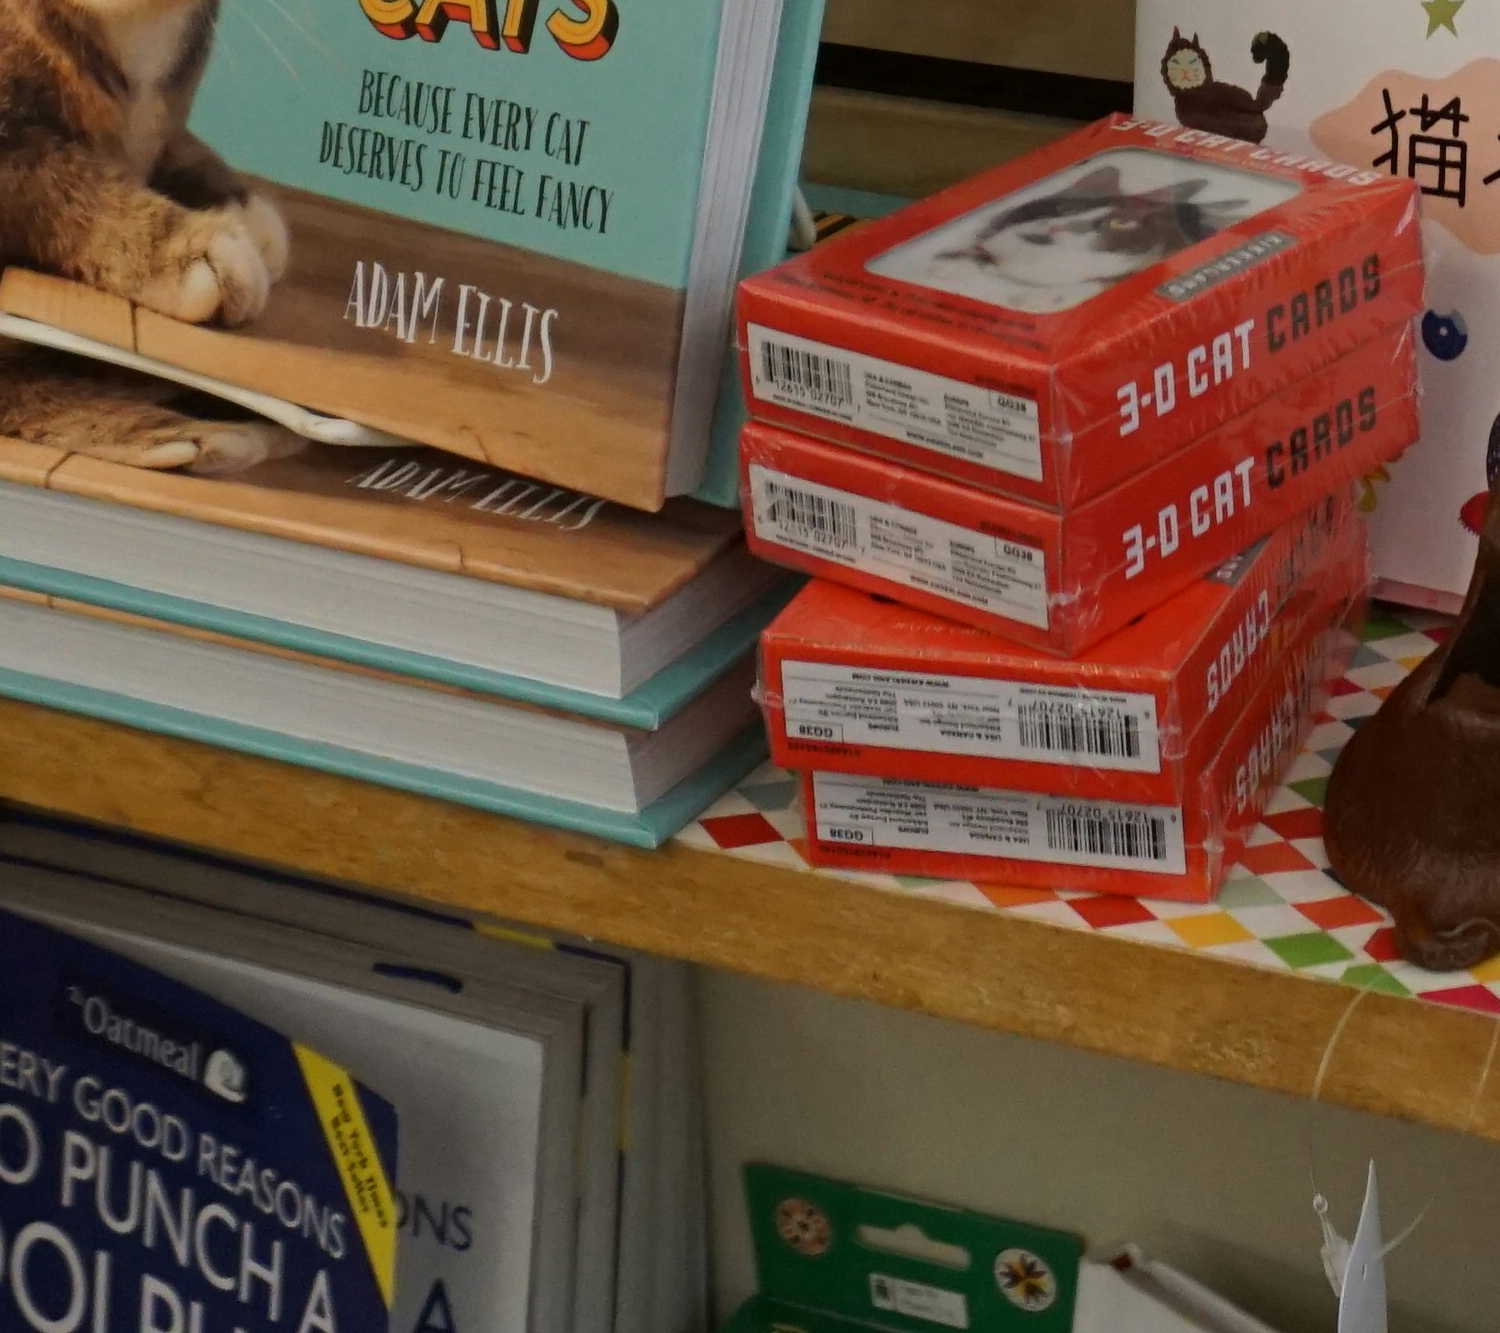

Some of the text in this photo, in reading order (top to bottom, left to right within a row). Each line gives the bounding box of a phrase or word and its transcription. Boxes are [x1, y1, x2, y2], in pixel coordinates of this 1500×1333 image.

[357, 68, 590, 166] BECAUSE EVERY CAT
[318, 120, 614, 234] DESERVES TO FEEL FANCY
[342, 260, 561, 384] ADAM ELLIS
[82, 995, 200, 1080] Oatmeal
[73, 1075, 192, 1162] GOOD
[199, 1132, 348, 1260] REASONS
[61, 1129, 285, 1323] PUNCH
[299, 1269, 337, 1333] A
